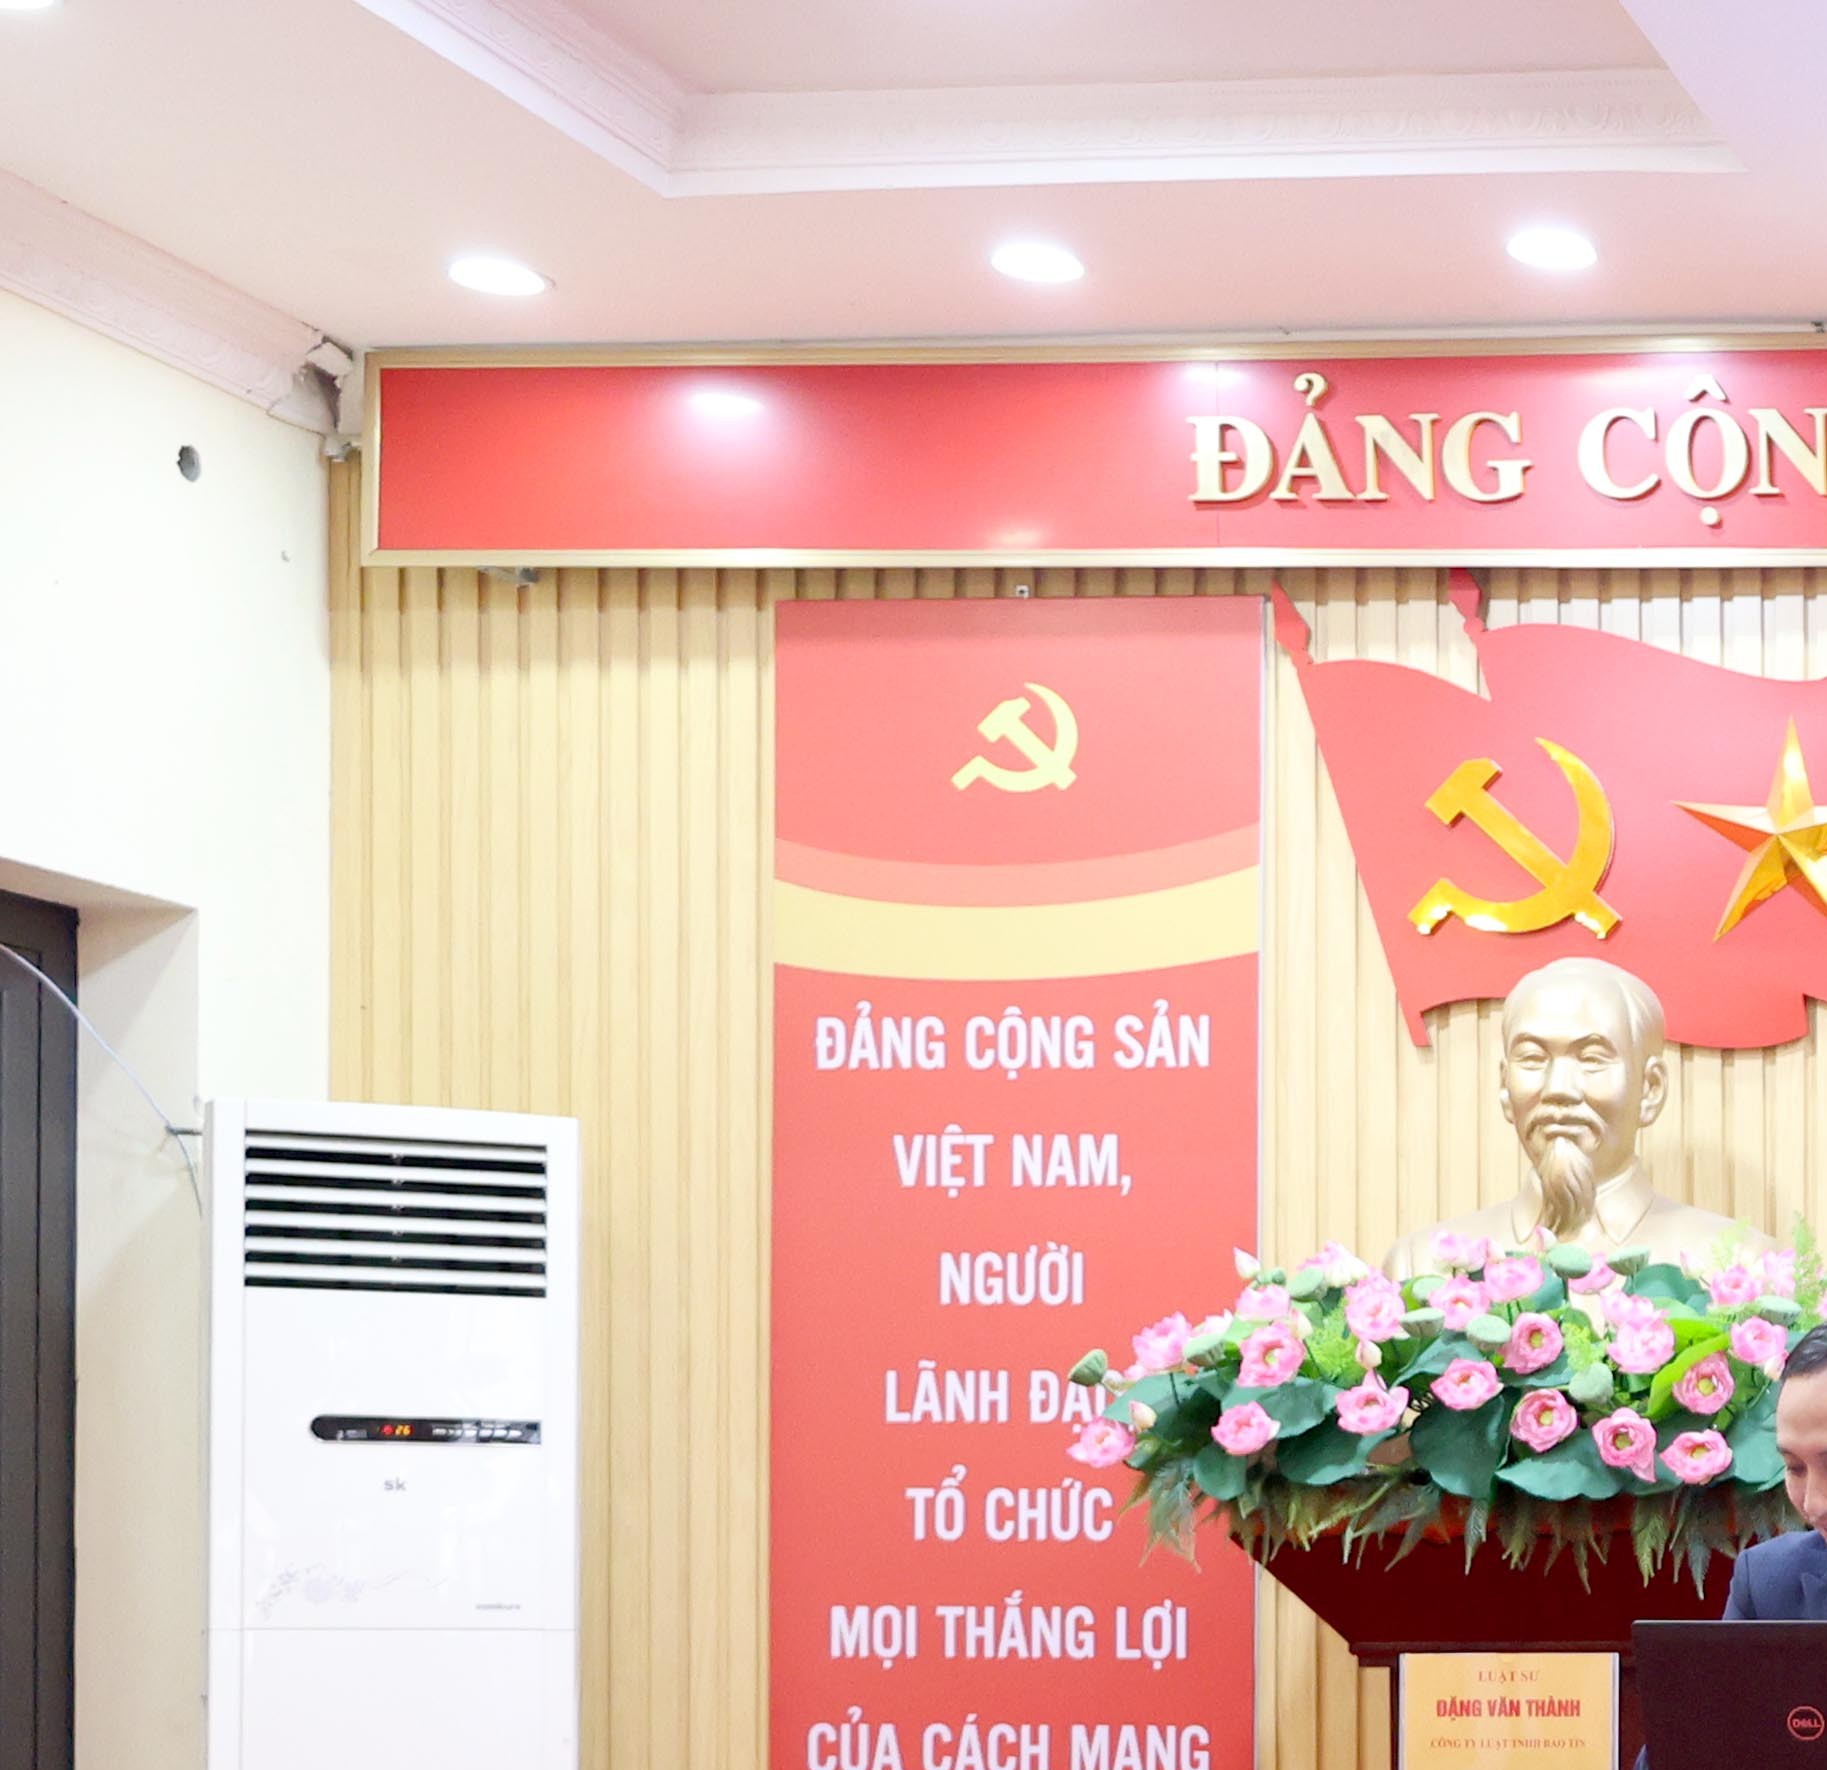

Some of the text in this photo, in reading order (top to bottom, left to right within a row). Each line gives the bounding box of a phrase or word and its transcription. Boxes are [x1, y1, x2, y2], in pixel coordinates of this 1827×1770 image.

[1191, 373, 1527, 502] ĐẢNG
[815, 999, 1210, 1079] ĐẢNG CỘNG SẢN
[893, 1124, 1132, 1198] VIỆT NAM,
[939, 1241, 1085, 1306] NGƯỜI
[885, 1360, 1008, 1423] LÃNH
[905, 1464, 1113, 1541] TỔ CHỨC
[830, 1590, 1187, 1670] MỌI THẮNG LỢI
[1488, 1696, 1520, 1717] VĂN
[1792, 1718, 1822, 1728] DELL
